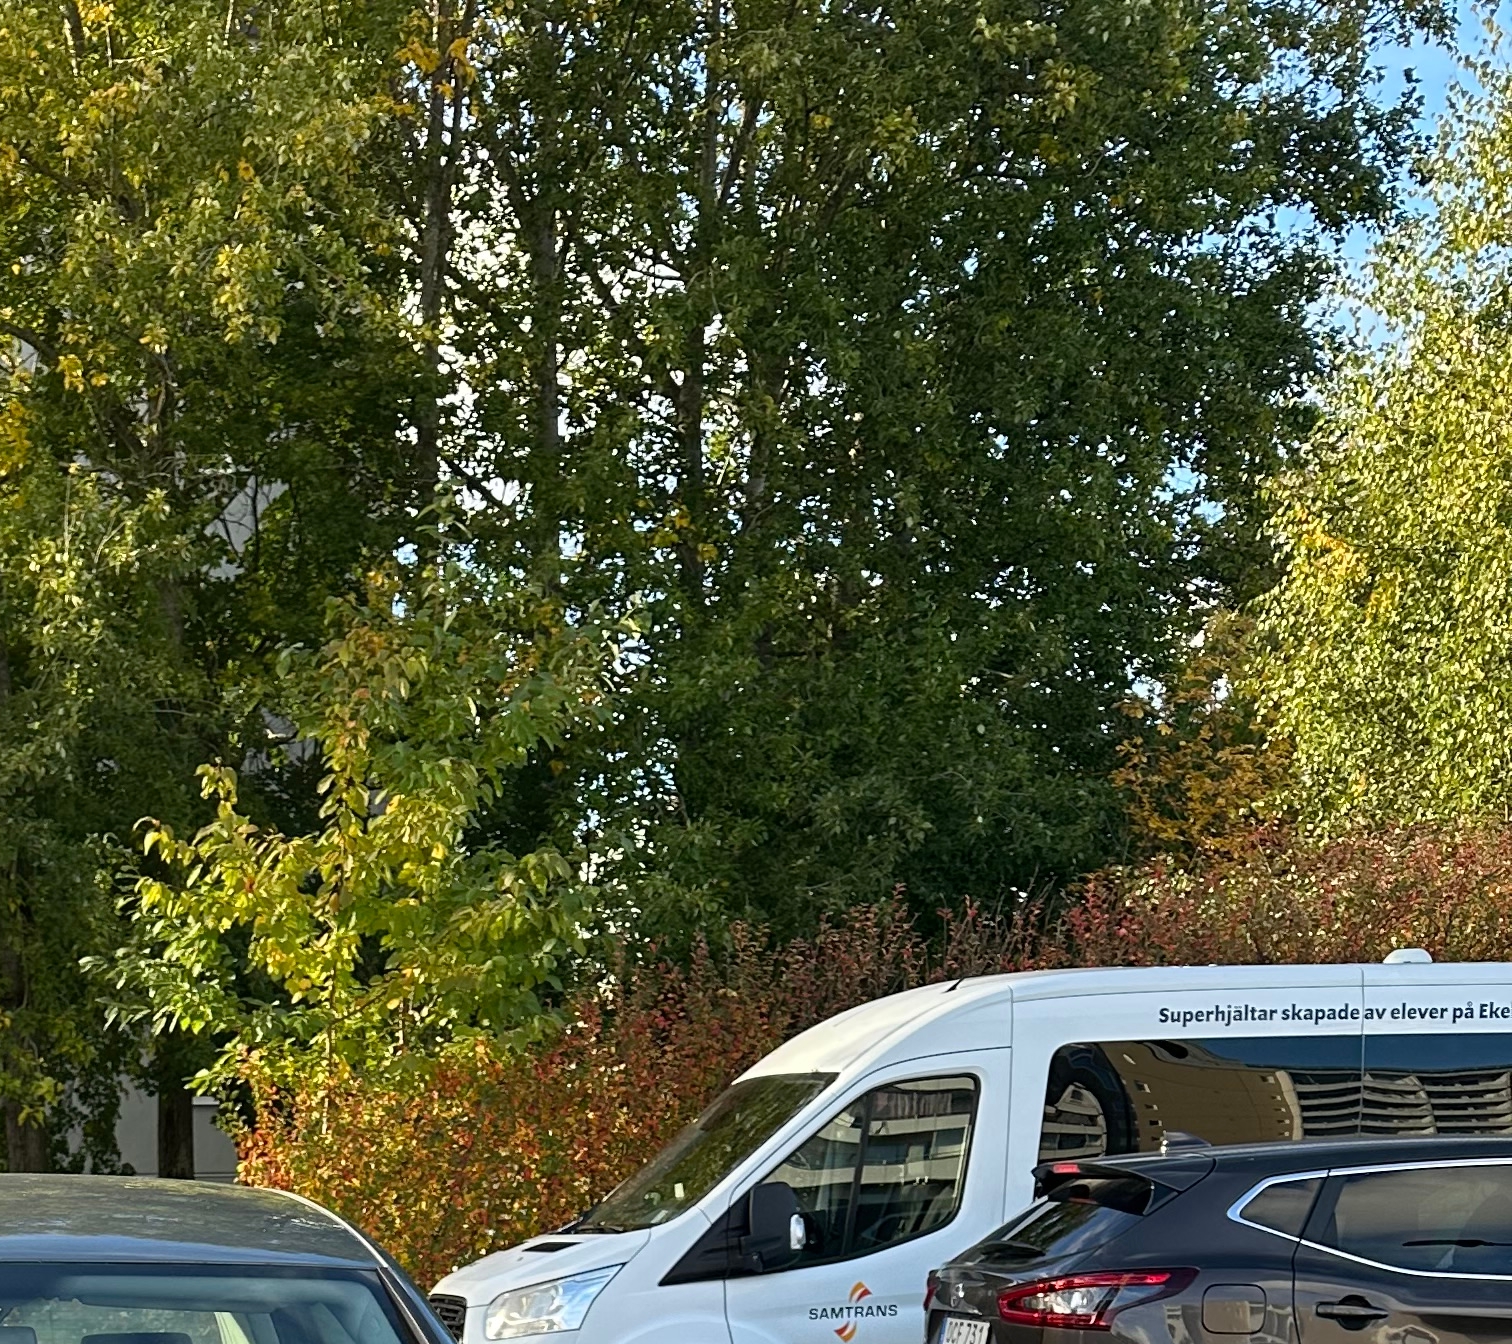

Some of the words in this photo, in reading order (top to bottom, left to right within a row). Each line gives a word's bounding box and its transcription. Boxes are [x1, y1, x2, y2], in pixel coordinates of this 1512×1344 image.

[1159, 1003, 1278, 1027] Superhjältar
[1281, 1003, 1360, 1025] skapade
[1364, 1006, 1386, 1020] av
[1390, 1002, 1448, 1020] elever
[1452, 1001, 1474, 1024] på
[1479, 1001, 1512, 1019] Eke
[808, 1304, 899, 1320] SAMTRANS
